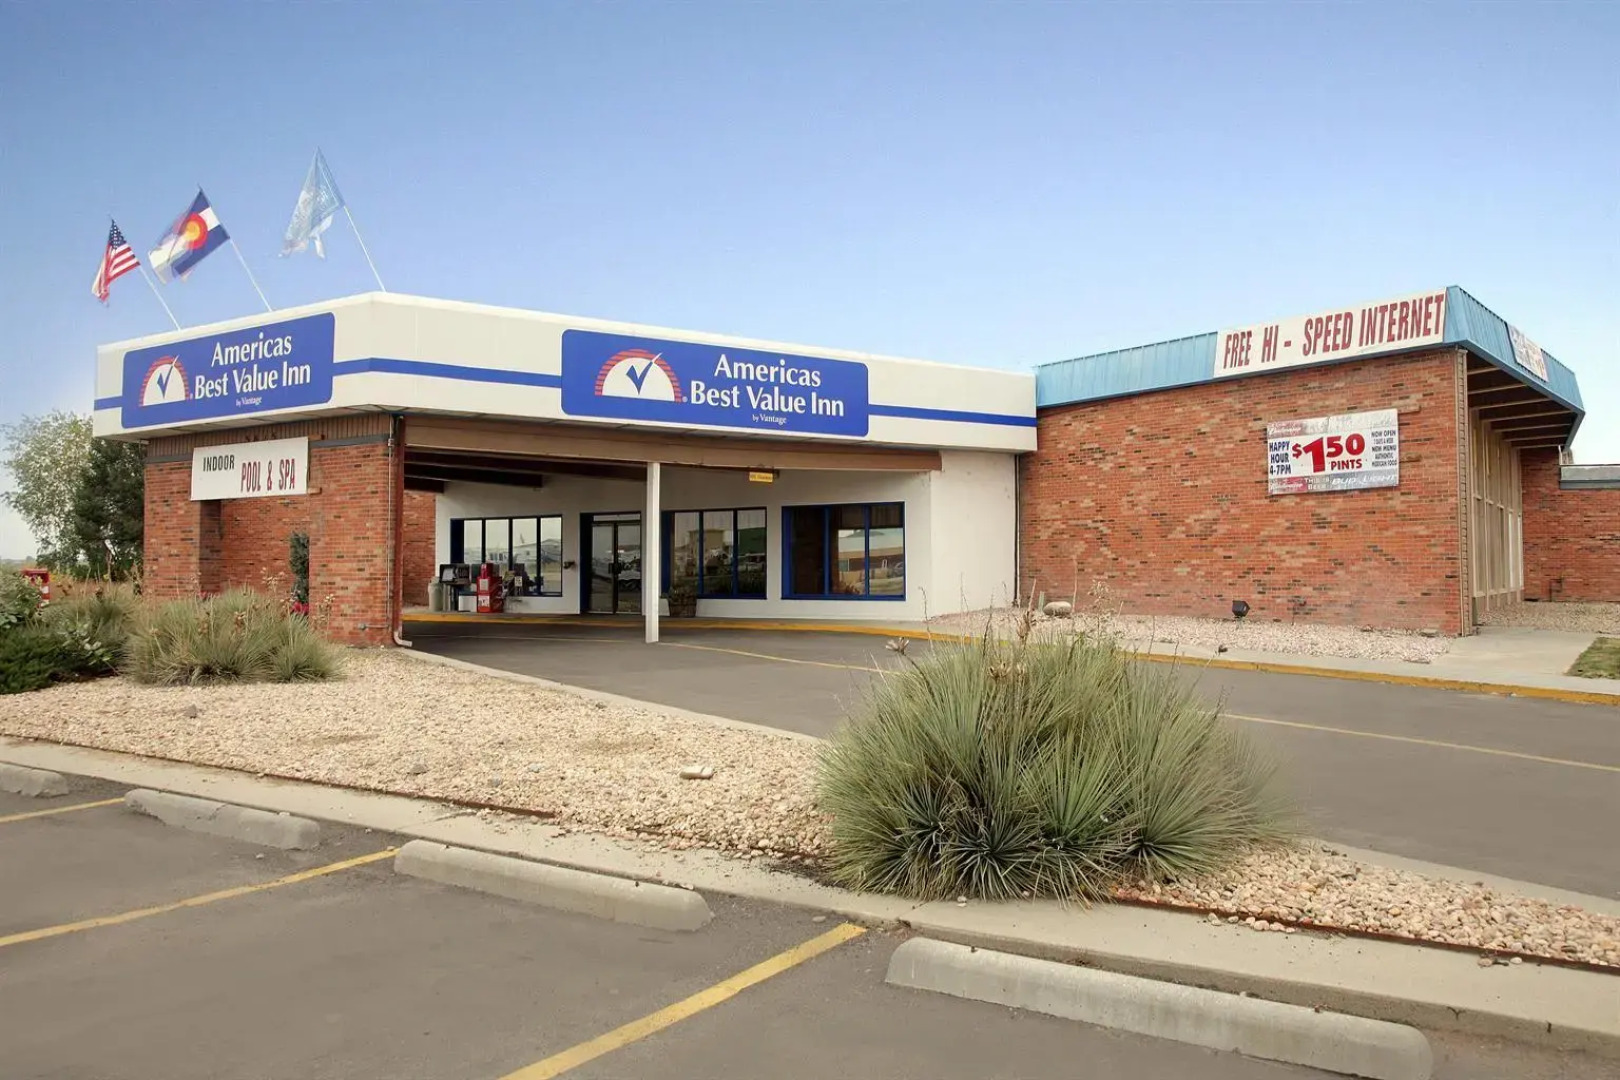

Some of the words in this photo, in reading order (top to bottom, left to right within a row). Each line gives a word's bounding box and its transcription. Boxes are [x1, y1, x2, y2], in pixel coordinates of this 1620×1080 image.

[1223, 330, 1252, 369] FREE
[1261, 325, 1279, 363] HI
[1303, 311, 1353, 356] SPEED
[1358, 294, 1444, 347] INTERNET
[211, 332, 292, 367] Americas
[194, 372, 229, 400] Best
[233, 364, 278, 394] Value
[282, 361, 311, 387] Inn
[714, 353, 821, 387] Americas
[690, 380, 740, 408] Best
[746, 385, 806, 413] Value
[811, 391, 844, 416] Inn
[752, 414, 759, 423] by
[759, 413, 787, 426] Vantage
[1269, 441, 1290, 452] HAPPY
[1270, 453, 1289, 463] HOUR
[203, 454, 235, 472] INDOOR
[241, 461, 261, 493] POOL
[266, 460, 273, 491] &
[279, 458, 296, 490] SPA
[1269, 464, 1291, 475] 4-7PM
[1330, 459, 1362, 471] PINTS
